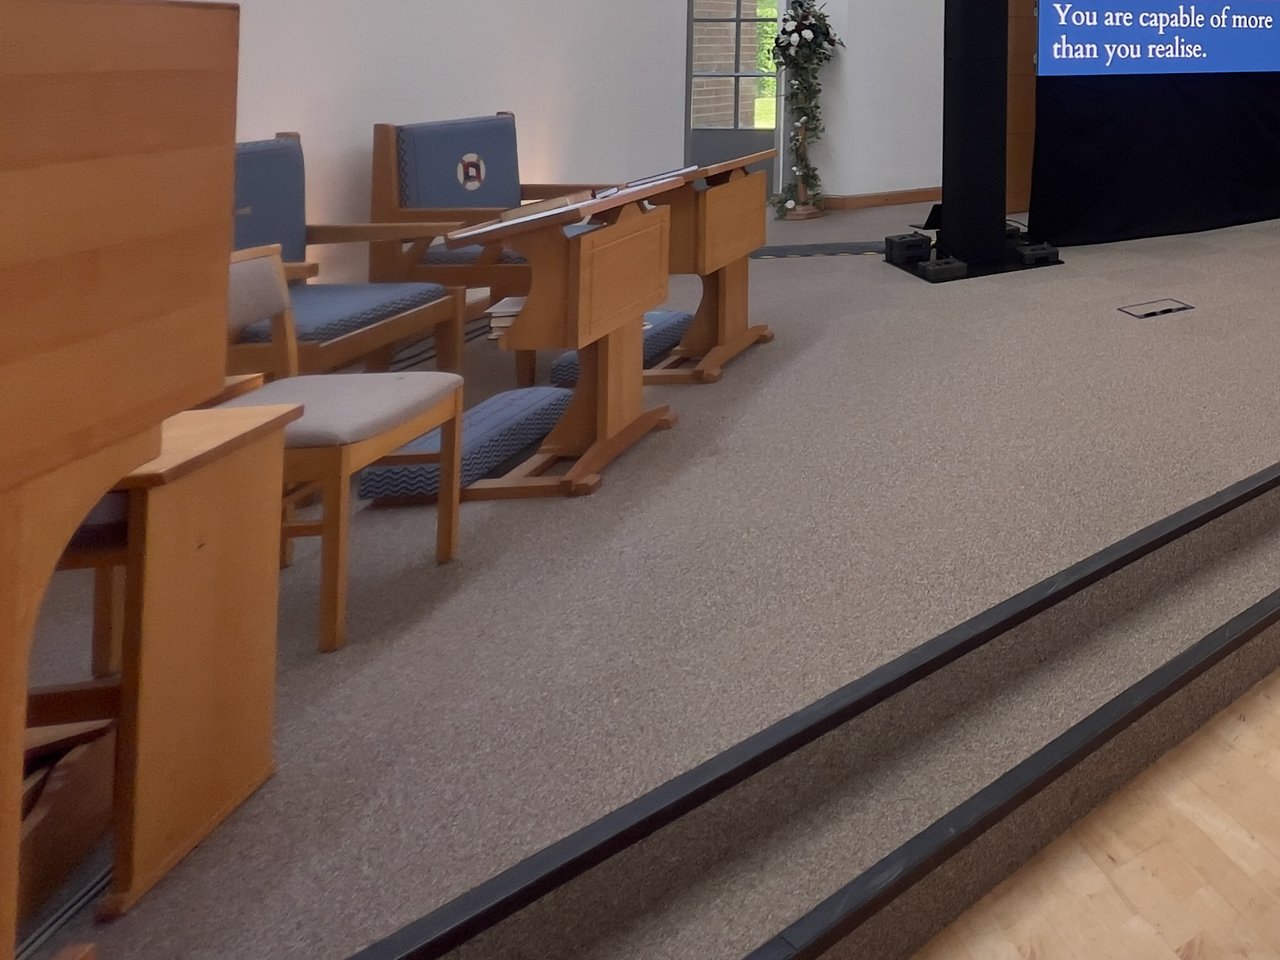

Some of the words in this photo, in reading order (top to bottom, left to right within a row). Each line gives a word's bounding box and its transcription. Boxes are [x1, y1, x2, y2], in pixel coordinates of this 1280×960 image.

[1053, 3, 1098, 26] You
[1104, 11, 1133, 26] are
[1139, 5, 1204, 35] capable
[1210, 5, 1231, 28] of
[1231, 14, 1273, 28] more
[1052, 34, 1099, 59] than
[1104, 43, 1142, 67] you
[1147, 35, 1207, 59] realise.
